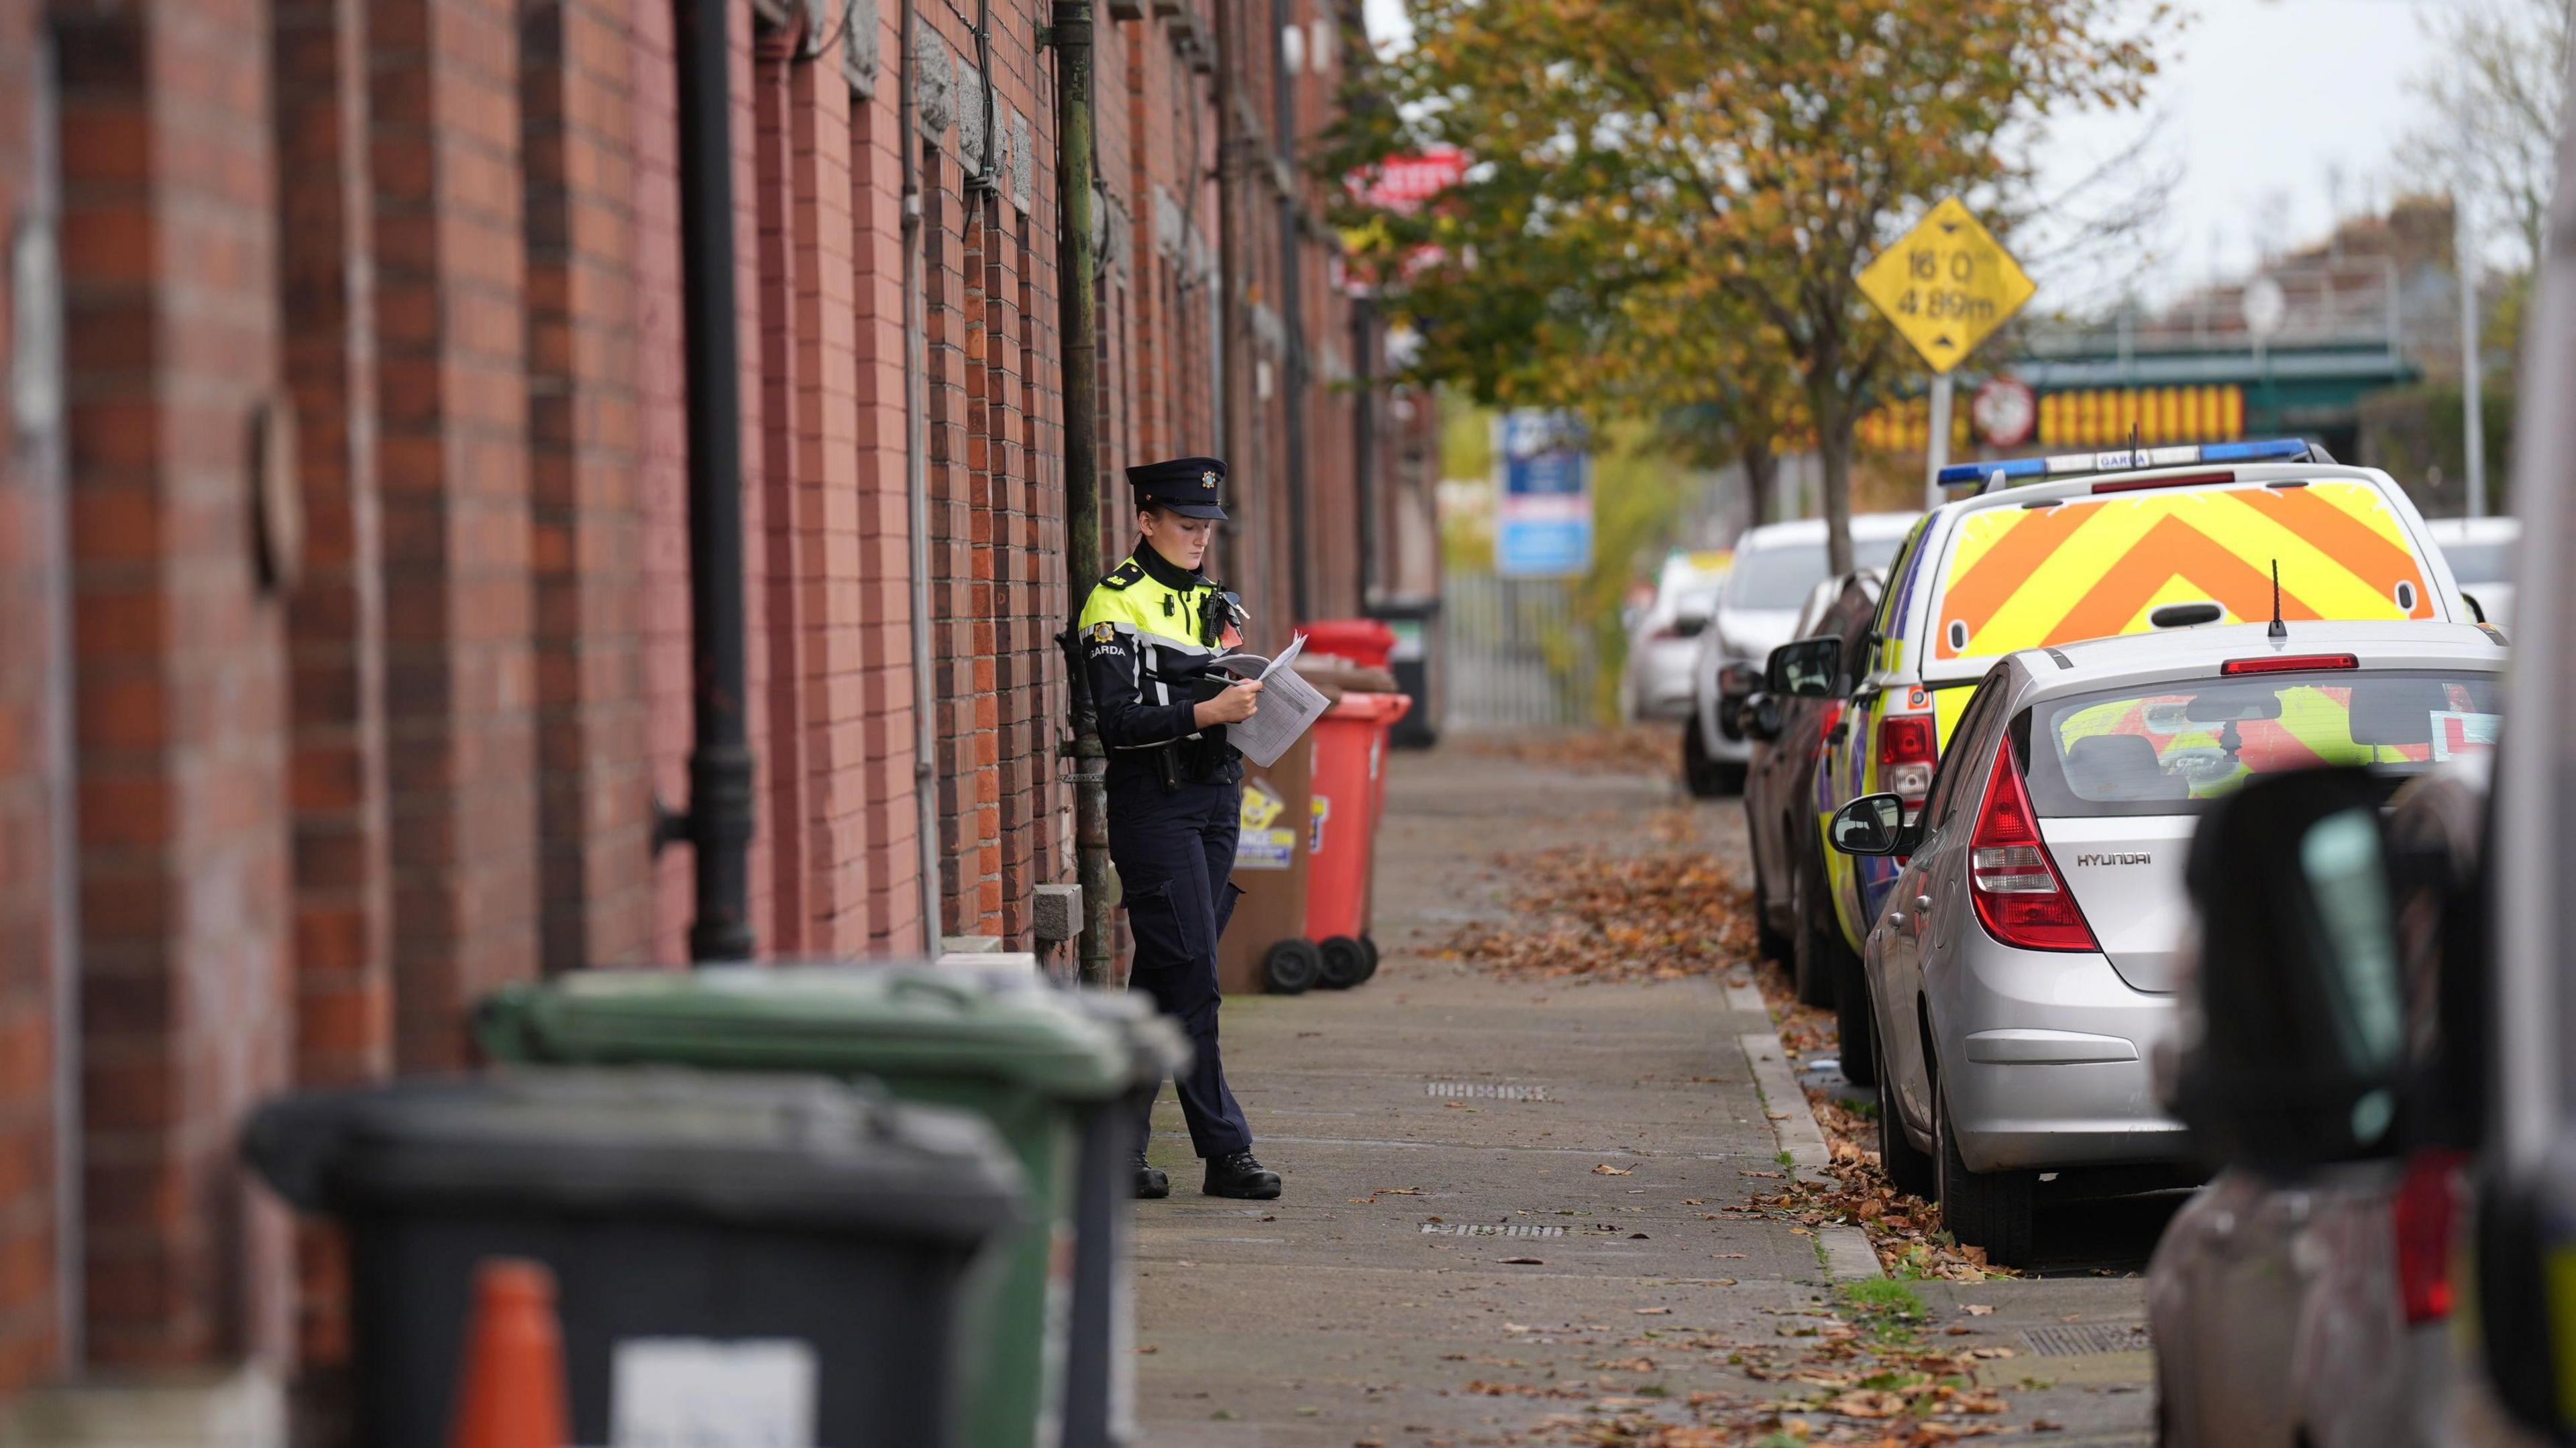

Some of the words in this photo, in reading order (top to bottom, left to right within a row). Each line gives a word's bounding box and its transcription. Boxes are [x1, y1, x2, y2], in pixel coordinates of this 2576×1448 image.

[2101, 454, 2145, 466] GARA
[1089, 645, 1126, 659] GARDA
[2077, 852, 2151, 867] HYUNDAI
